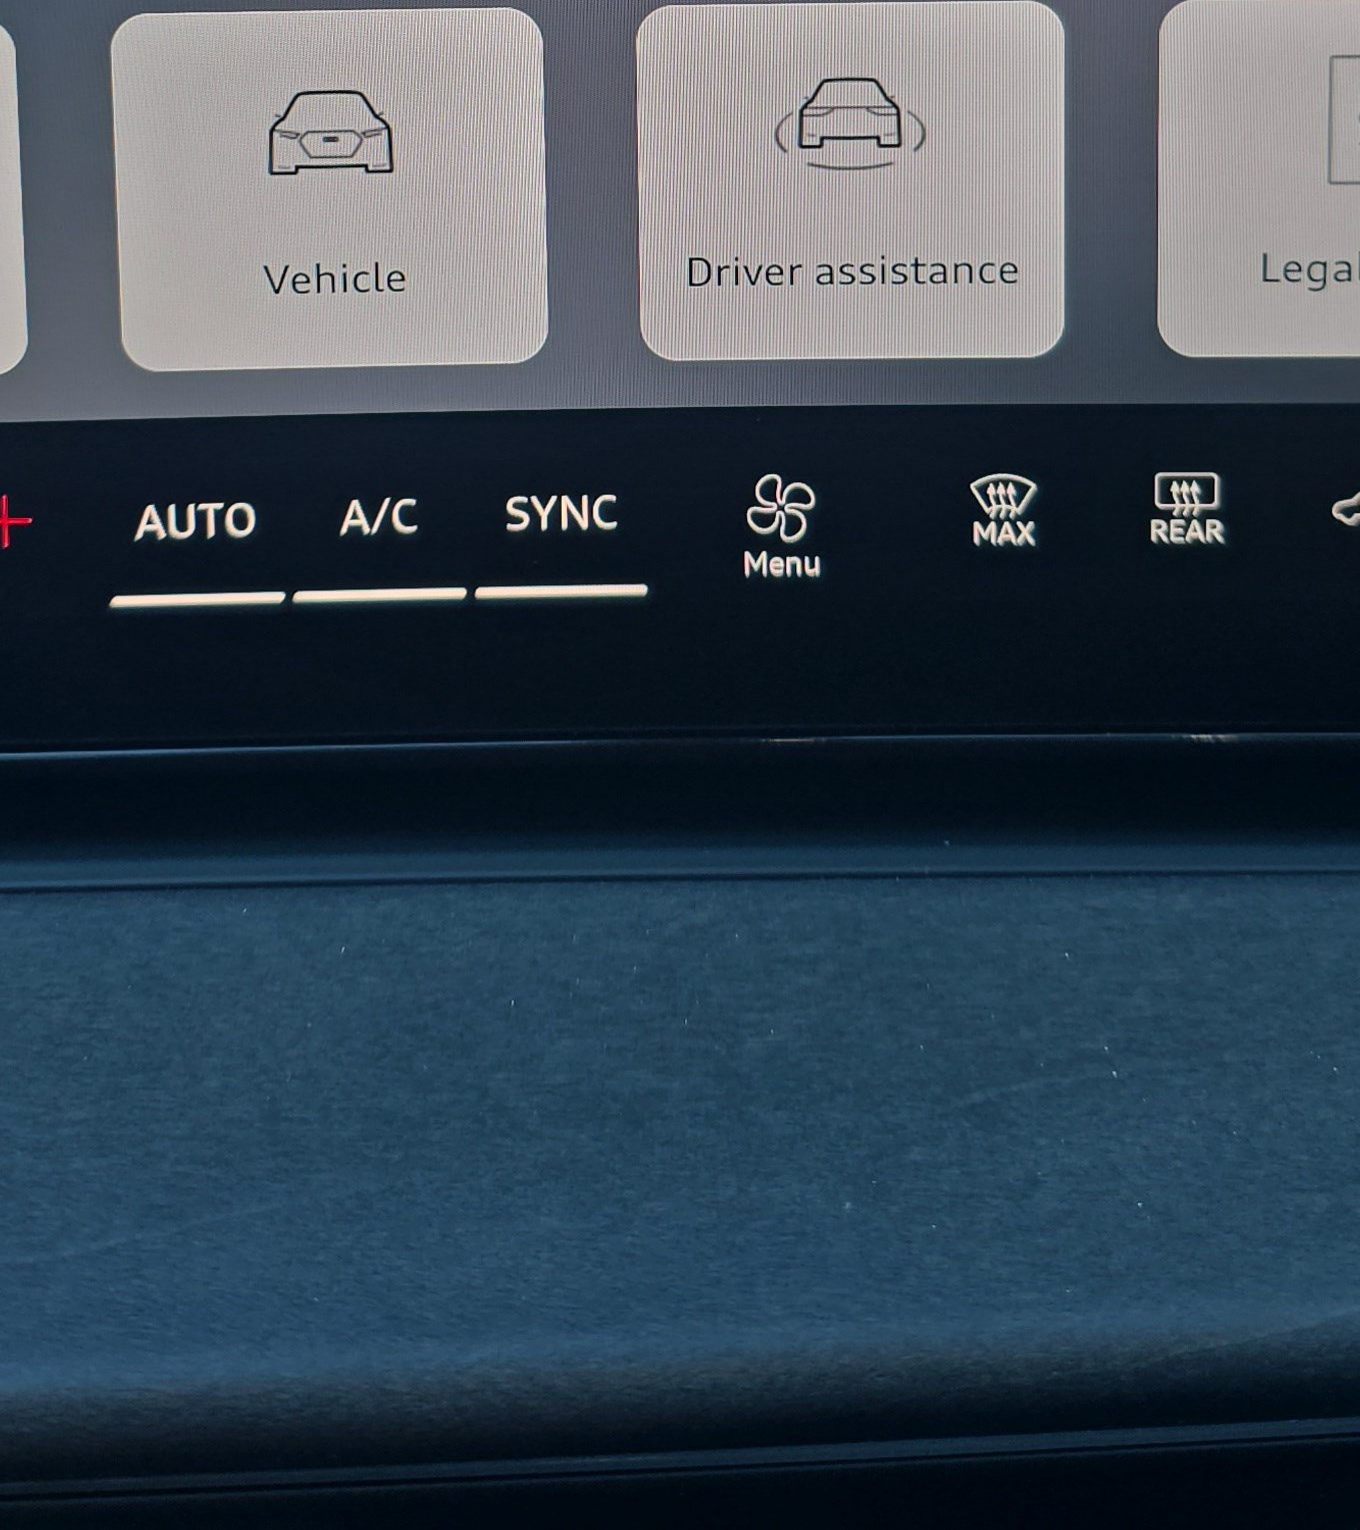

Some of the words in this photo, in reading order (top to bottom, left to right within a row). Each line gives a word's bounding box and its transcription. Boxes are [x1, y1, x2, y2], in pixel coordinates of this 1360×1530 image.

[263, 262, 405, 294] Vehicle
[689, 257, 802, 287] Driver
[816, 257, 1018, 285] assistance
[135, 502, 256, 541] AUTO
[340, 497, 417, 535] A/C
[506, 494, 617, 531] SYNC
[973, 521, 1035, 545] MAX
[1151, 520, 1224, 543] REAR
[744, 551, 820, 577] Menu
